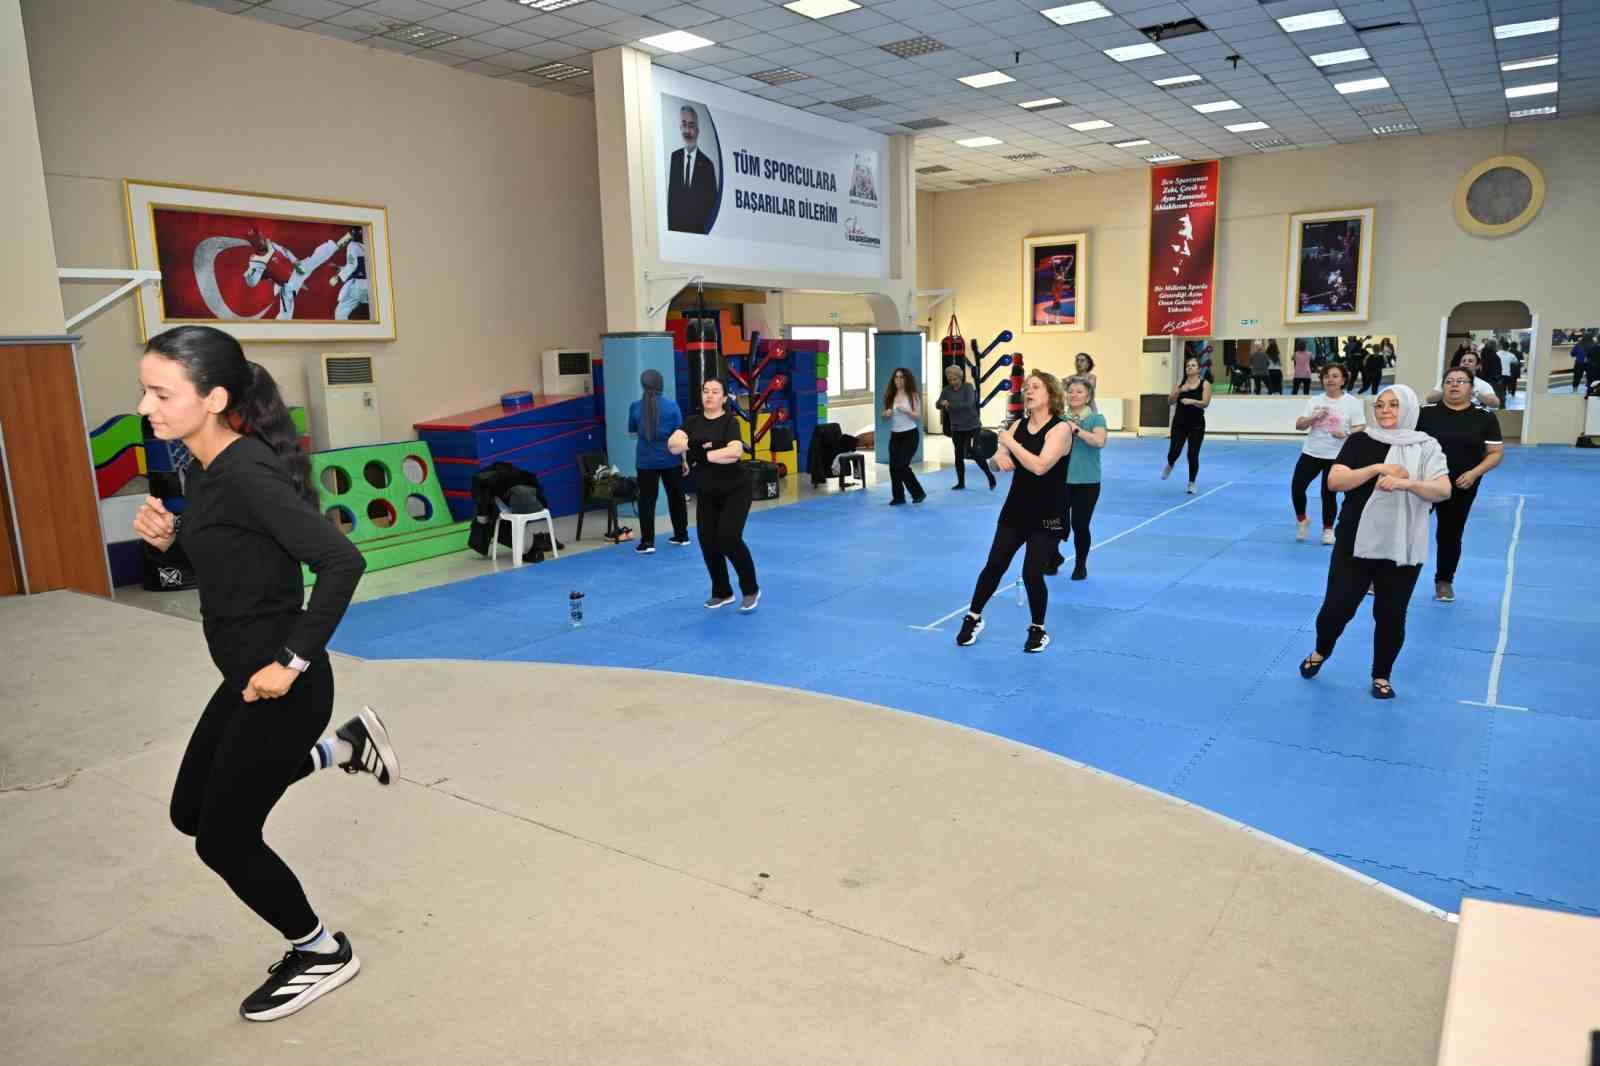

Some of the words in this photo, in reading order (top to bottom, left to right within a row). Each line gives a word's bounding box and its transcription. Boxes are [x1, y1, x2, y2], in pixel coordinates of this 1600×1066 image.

[733, 149, 760, 177] TÜM
[764, 158, 837, 192] SPORCULARA
[735, 189, 796, 217] BAŞARILAR
[798, 198, 838, 224] DİLERİM
